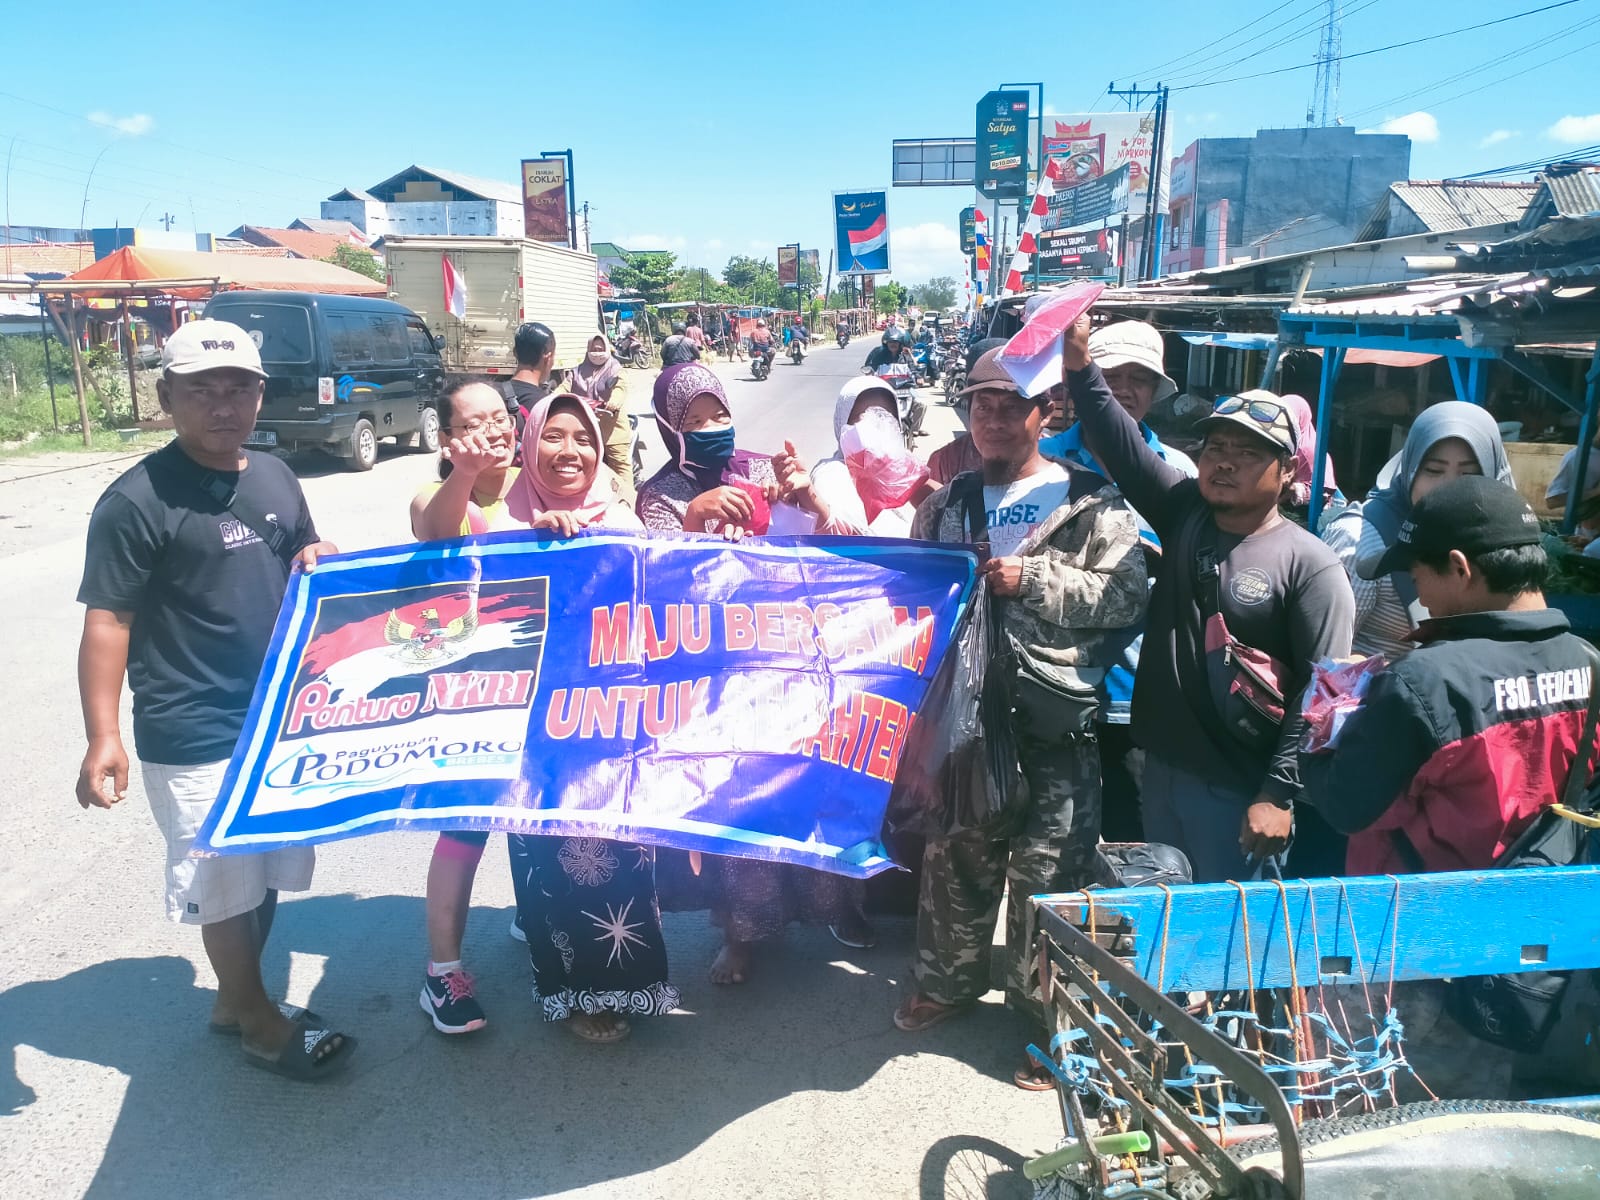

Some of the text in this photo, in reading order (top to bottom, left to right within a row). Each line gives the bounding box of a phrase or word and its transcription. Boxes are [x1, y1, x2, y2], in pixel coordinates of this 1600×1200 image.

[987, 122, 1017, 136] Satya
[528, 175, 561, 184] COKLAT
[589, 602, 934, 676] MAJU BERSAMA
[287, 669, 534, 734] Pantura NKRI
[546, 676, 712, 740] UNTUK
[335, 736, 439, 761] Paguyuban
